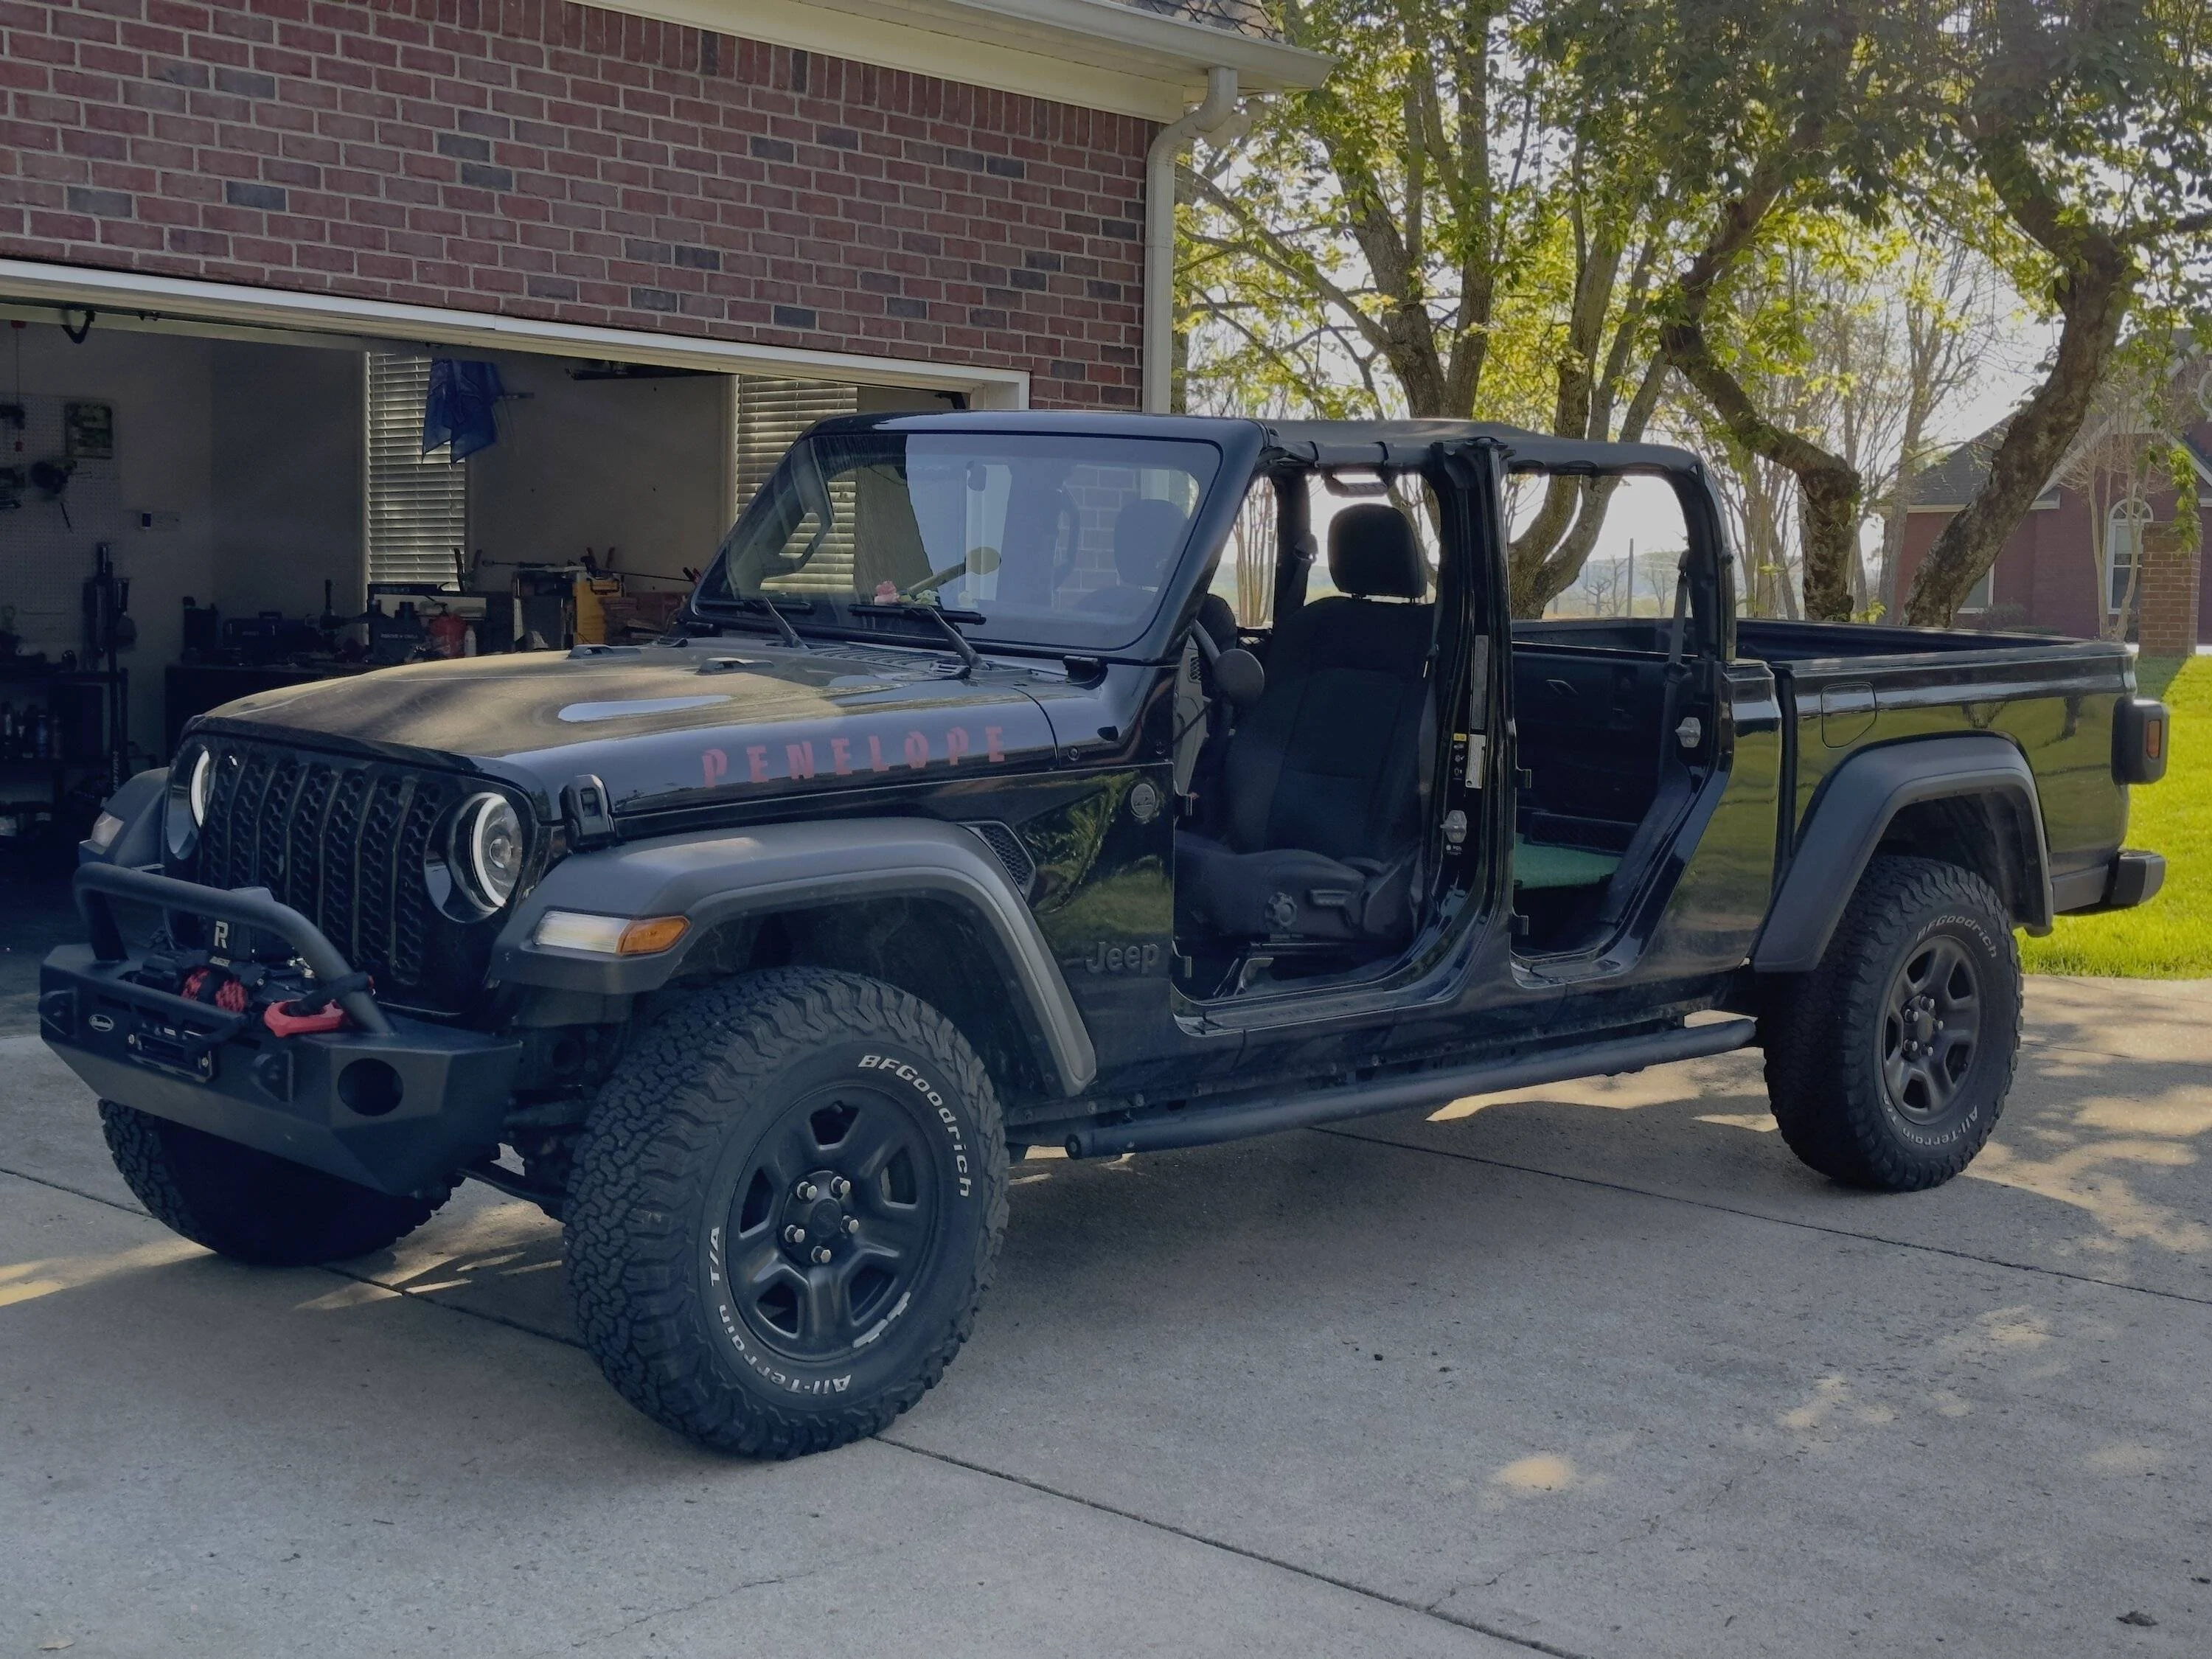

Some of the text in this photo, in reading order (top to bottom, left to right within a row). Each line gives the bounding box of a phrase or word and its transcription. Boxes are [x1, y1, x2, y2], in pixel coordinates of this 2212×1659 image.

[702, 726, 1005, 787] PENELOPE
[214, 920, 229, 949] R
[1085, 942, 1159, 974] Jeep
[858, 1055, 972, 1197] BFGoodrich
[709, 1227, 852, 1394] All-Terrain T/A
